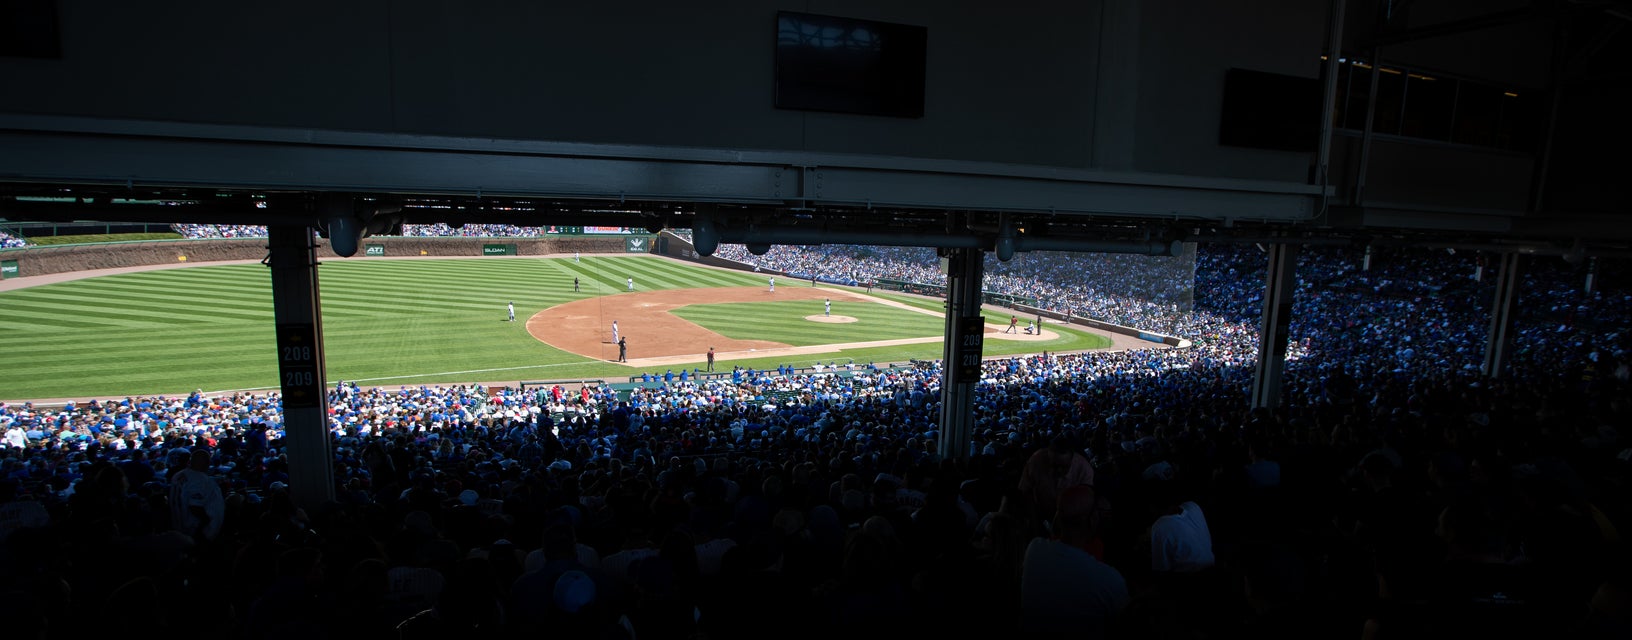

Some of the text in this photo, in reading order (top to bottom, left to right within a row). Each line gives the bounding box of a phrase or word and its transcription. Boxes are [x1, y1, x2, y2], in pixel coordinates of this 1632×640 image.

[963, 334, 981, 346] 209
[283, 346, 311, 361] 208
[962, 354, 978, 366] 210
[286, 372, 313, 386] 209
